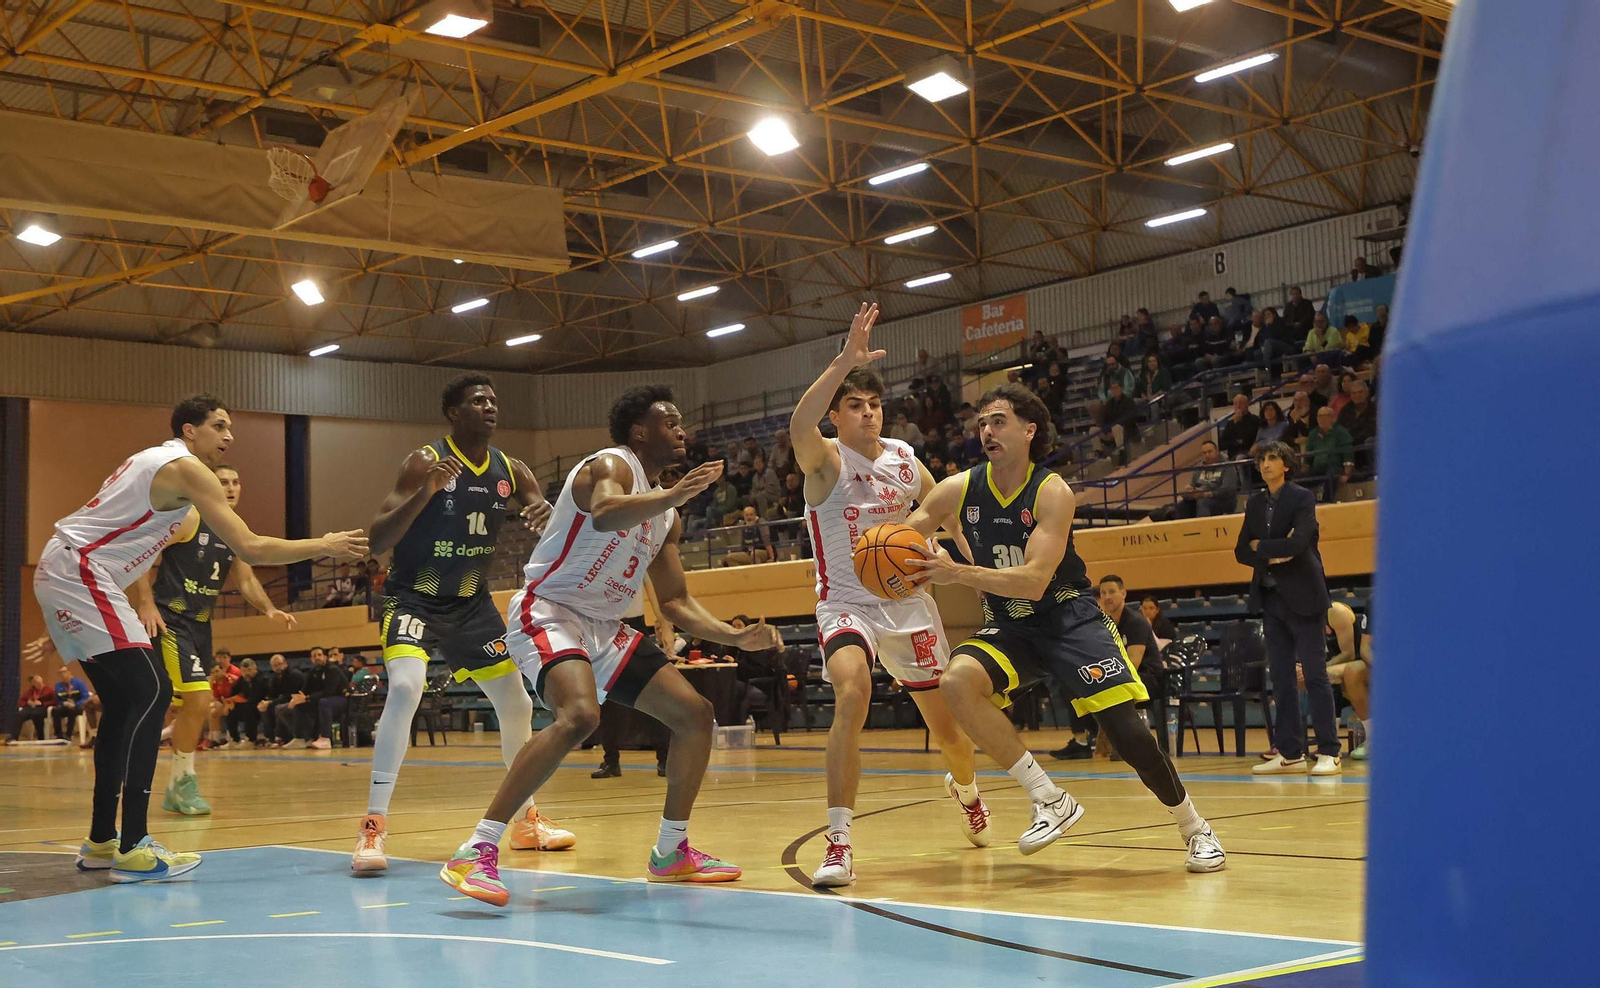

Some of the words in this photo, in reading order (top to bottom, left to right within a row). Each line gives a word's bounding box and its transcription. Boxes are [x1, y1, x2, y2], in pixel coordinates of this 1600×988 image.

[1215, 251, 1226, 275] B
[982, 304, 1005, 320] Bar
[867, 507, 887, 515] CAJA
[1121, 532, 1169, 546] PRENSA
[622, 555, 640, 579] 3
[992, 544, 1025, 570] 30
[210, 561, 220, 581] 2
[397, 613, 427, 640] 10
[190, 654, 204, 672] 2
